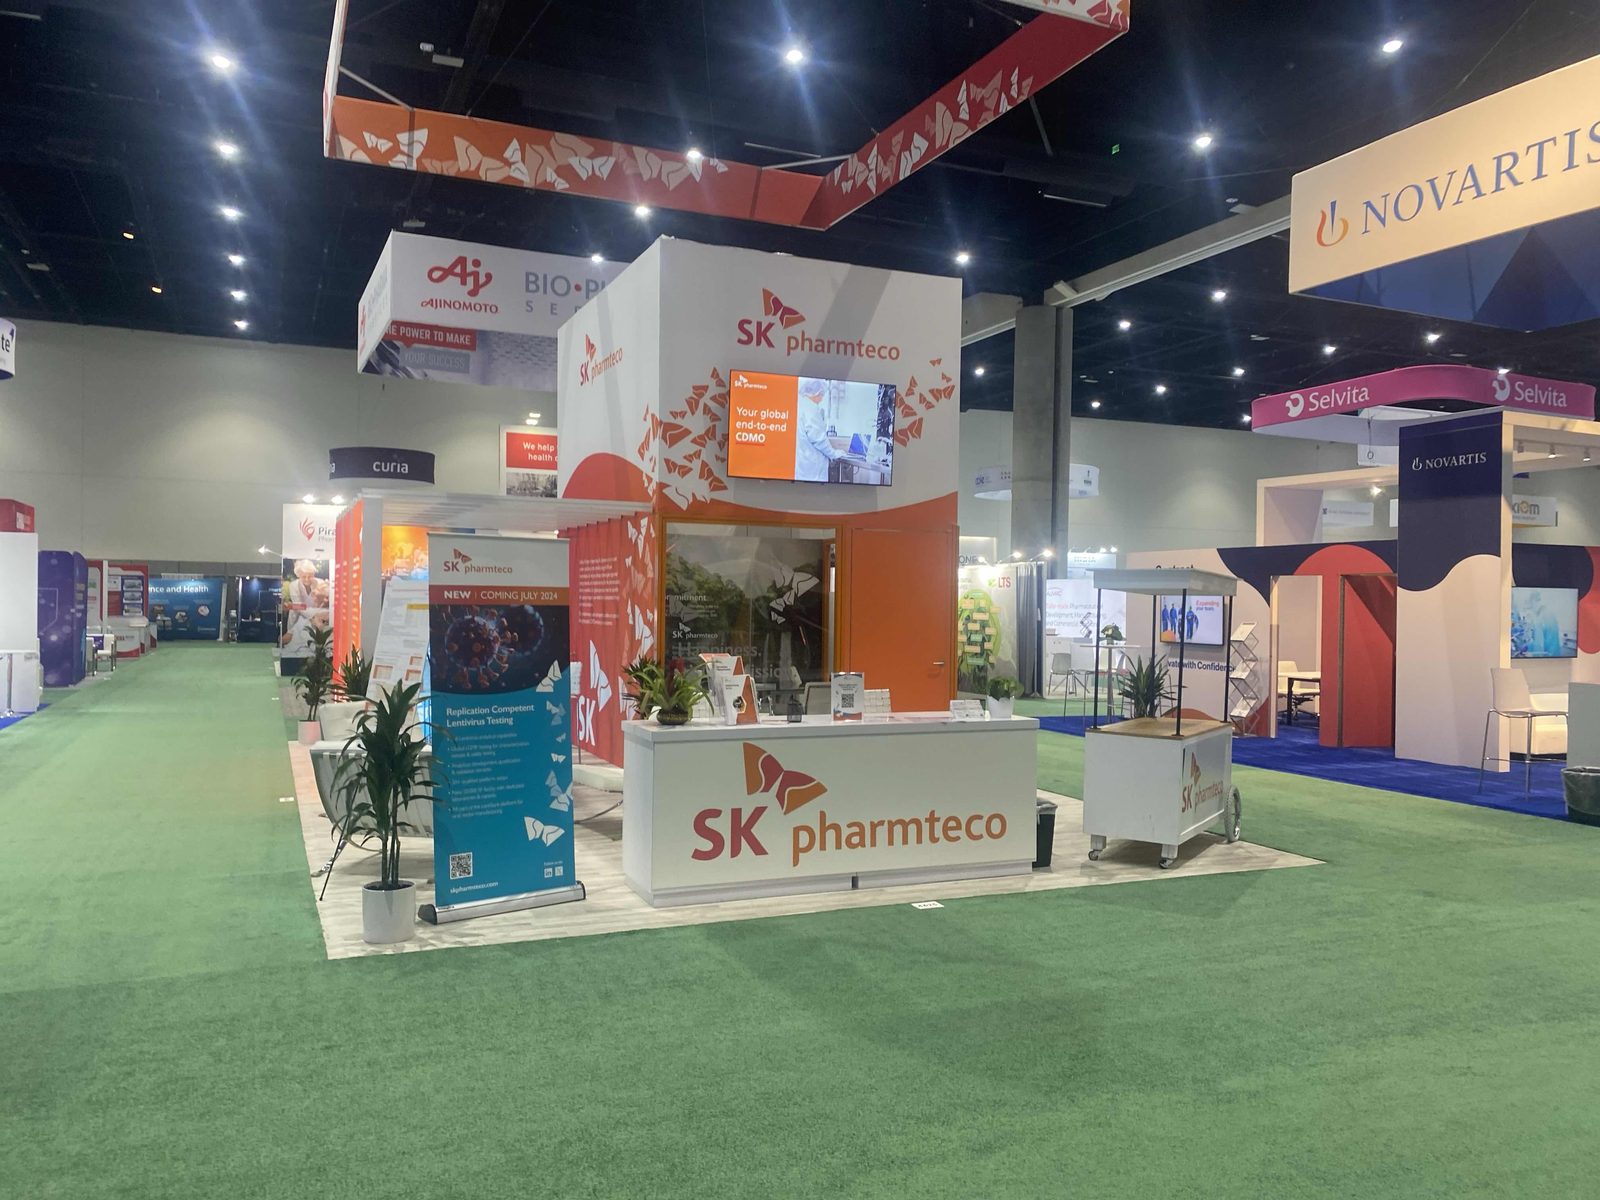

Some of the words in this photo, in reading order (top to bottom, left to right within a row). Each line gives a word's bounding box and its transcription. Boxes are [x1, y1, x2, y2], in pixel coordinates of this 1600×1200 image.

[1361, 120, 1600, 235] NOVARTIS
[420, 298, 498, 314] AJINOMOTO
[400, 327, 430, 339] POWER
[433, 330, 443, 341] TO
[446, 333, 471, 345] MAKE
[736, 319, 775, 348] SK
[786, 331, 900, 360] pharmteco
[404, 351, 427, 364] YOUR
[428, 354, 465, 369] SUCCESS
[580, 361, 589, 386] SK
[591, 347, 623, 384] pharmteco
[743, 382, 767, 390] pharmteco
[1308, 385, 1370, 412] Selvita
[1514, 380, 1567, 407] Selvita
[736, 407, 758, 417] Your
[760, 408, 788, 420] global
[736, 421, 787, 432] end-to-end
[735, 432, 765, 443] CDMO
[523, 442, 535, 450] We
[537, 443, 555, 452] help
[528, 453, 552, 462] health
[1425, 452, 1487, 470] NOVARTIS
[373, 461, 408, 473] curia
[443, 561, 460, 572] SK
[464, 564, 513, 575] pharmteco
[166, 585, 181, 593] and
[183, 585, 209, 593] Health
[998, 577, 1011, 588] LTS
[444, 590, 471, 599] NEW
[480, 591, 518, 600] COMING
[520, 592, 538, 601] JULY
[541, 592, 558, 600] 2024
[672, 631, 683, 639] SK
[685, 632, 718, 640] pharmteco
[446, 706, 490, 717] Replication
[491, 704, 534, 716] Competent
[446, 718, 486, 728] Lentivirus
[487, 717, 514, 728] Testing
[578, 695, 596, 747] SK
[1181, 783, 1193, 813] SK
[1195, 780, 1223, 813] pharmteco
[691, 805, 769, 861] SK
[792, 810, 1007, 867] pharmteco
